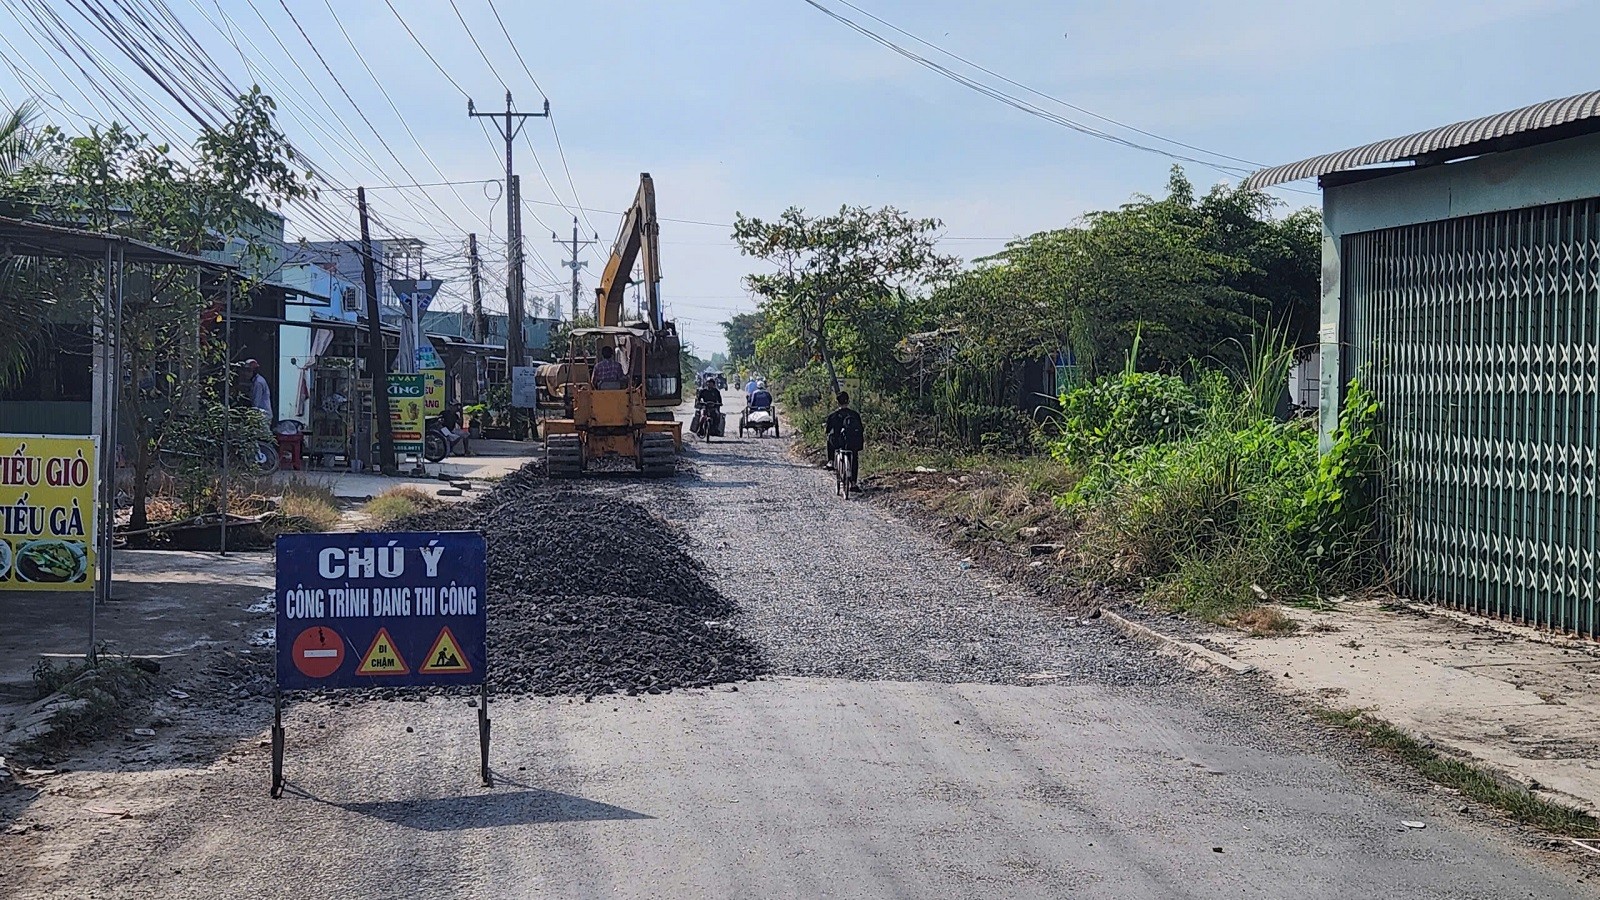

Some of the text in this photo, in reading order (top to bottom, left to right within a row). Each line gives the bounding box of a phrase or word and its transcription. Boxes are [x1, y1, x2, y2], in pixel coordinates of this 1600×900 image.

[0, 443, 89, 487] IẾU GIÒ
[50, 498, 84, 535] GÀ
[318, 540, 445, 579] CHÚ Ý
[286, 581, 477, 619] CÔNG TRÌNH ĐANG THI CÔNG
[371, 658, 395, 669] CHẬM
[378, 644, 388, 654] ĐI
